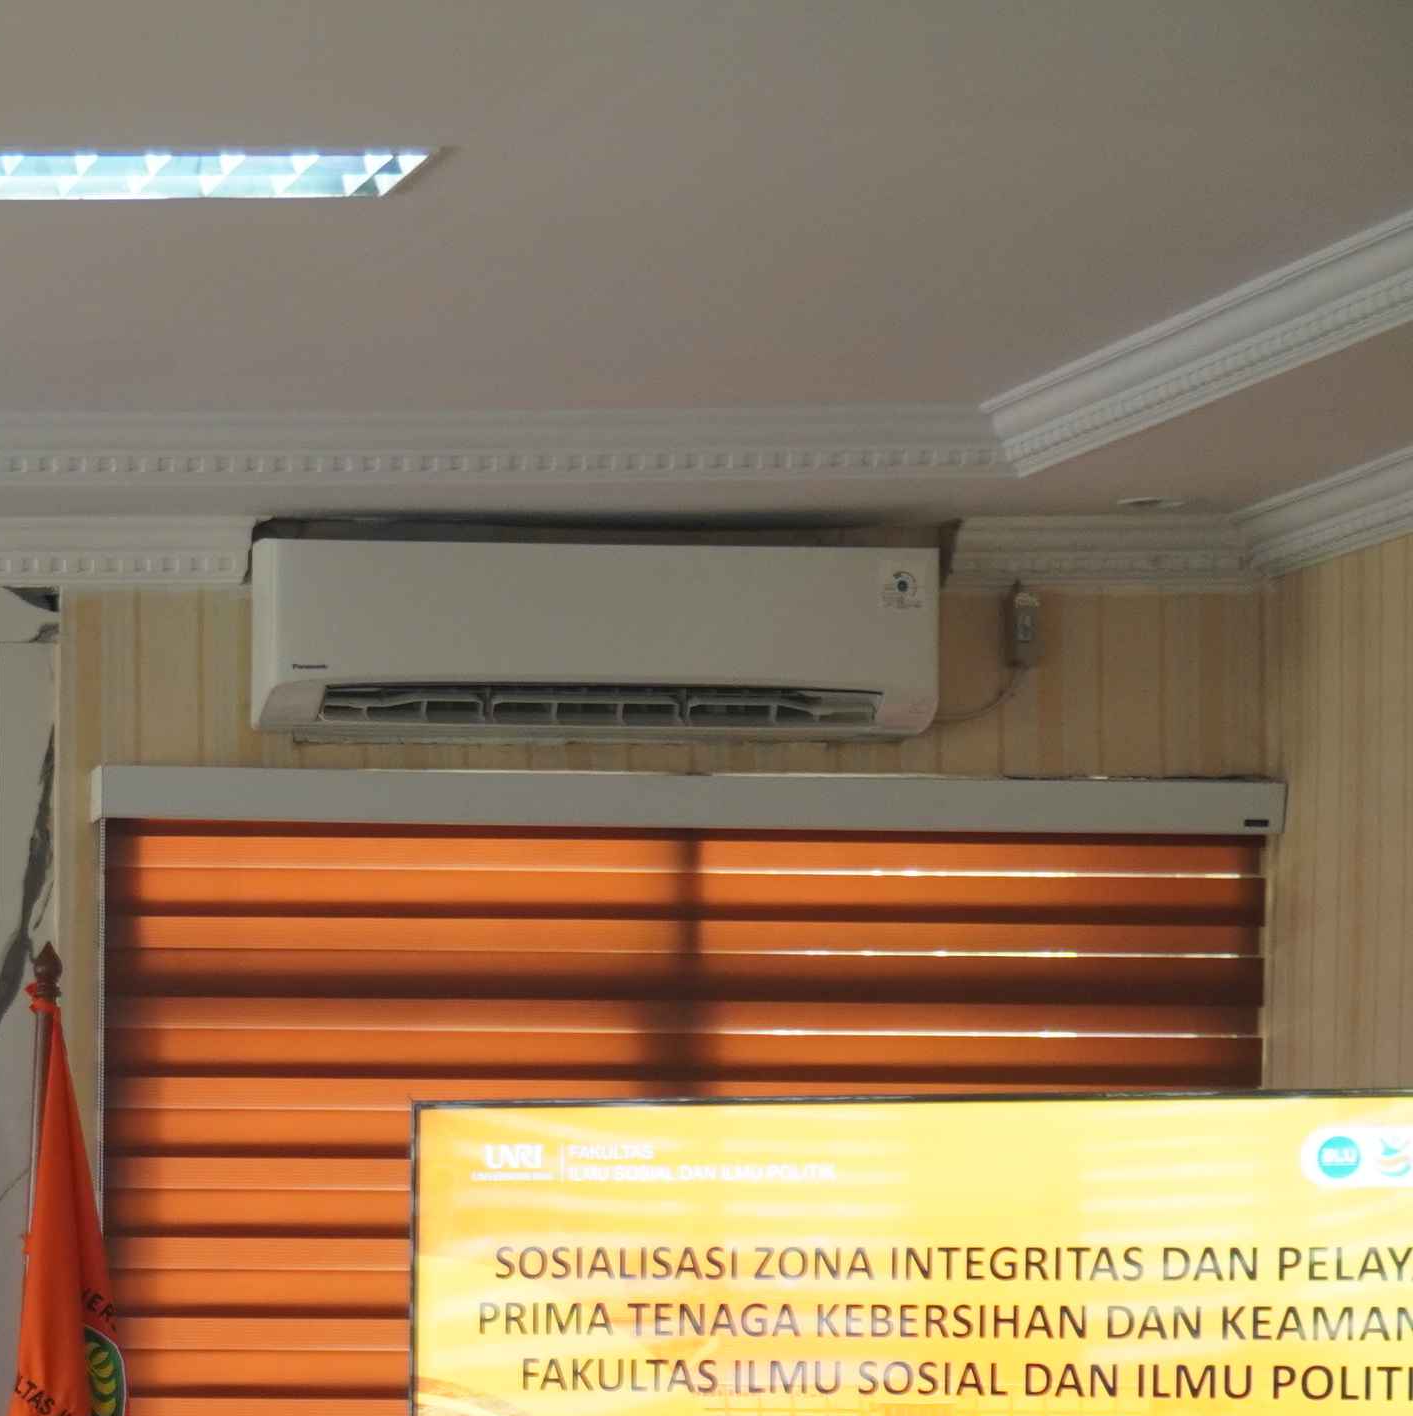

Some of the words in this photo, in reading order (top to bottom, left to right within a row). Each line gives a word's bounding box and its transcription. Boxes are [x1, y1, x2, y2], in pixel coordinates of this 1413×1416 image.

[495, 1246, 739, 1281] SOSIALISASI
[753, 1246, 874, 1281] ZONA
[890, 1246, 1144, 1281] INTEGRITAS
[1162, 1246, 1259, 1281] DAN
[1278, 1246, 1413, 1281] PELAY
[479, 1302, 614, 1335] PRIMA
[627, 1302, 801, 1337] TENAGA
[816, 1303, 1087, 1339] KEBERSIHAN
[1106, 1305, 1202, 1340] DAN
[522, 1358, 719, 1394] FAKULTAS
[733, 1359, 841, 1395] ILMU
[857, 1360, 1009, 1396] SOSIAL
[1023, 1362, 1118, 1398] DAN
[1137, 1363, 1253, 1400] ILMU
